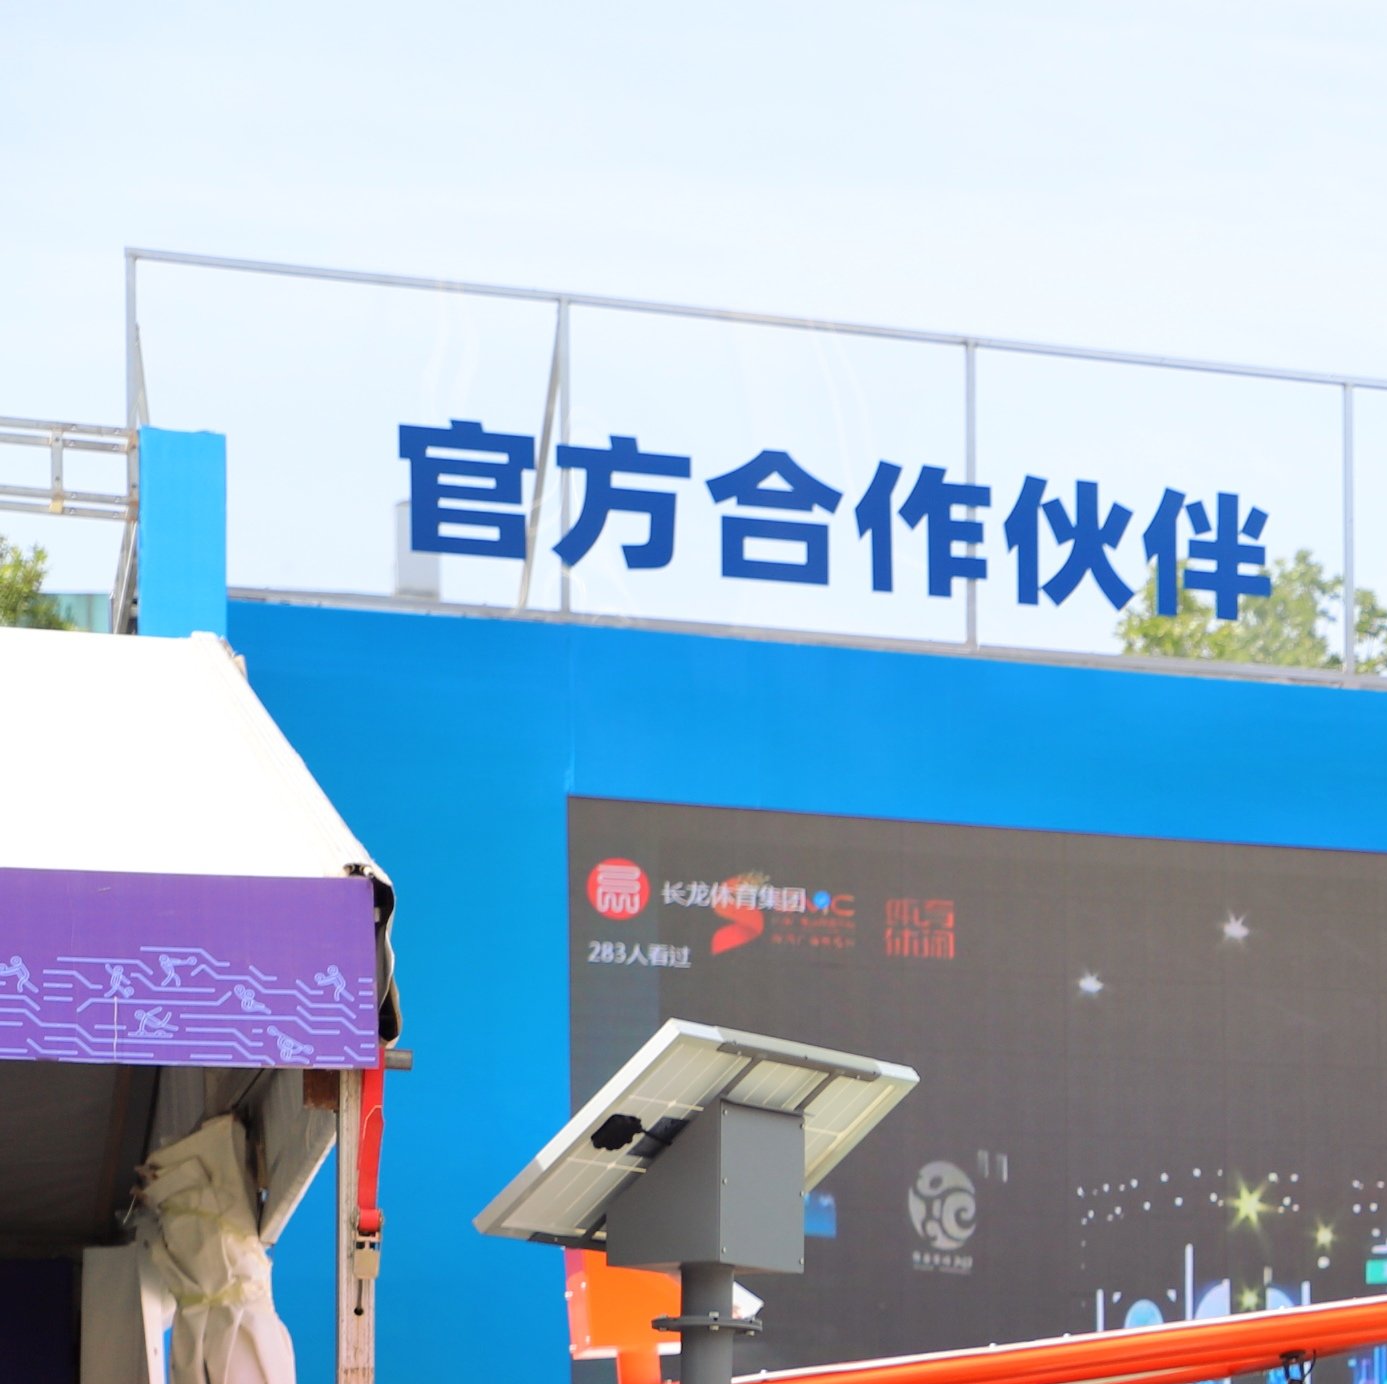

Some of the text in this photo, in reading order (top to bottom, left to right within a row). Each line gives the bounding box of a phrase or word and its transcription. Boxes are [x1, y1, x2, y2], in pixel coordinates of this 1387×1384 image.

[398, 418, 1272, 622] 官方合作伙伴
[661, 881, 807, 914] 长龙体育集团
[587, 939, 693, 969] 283人看过
